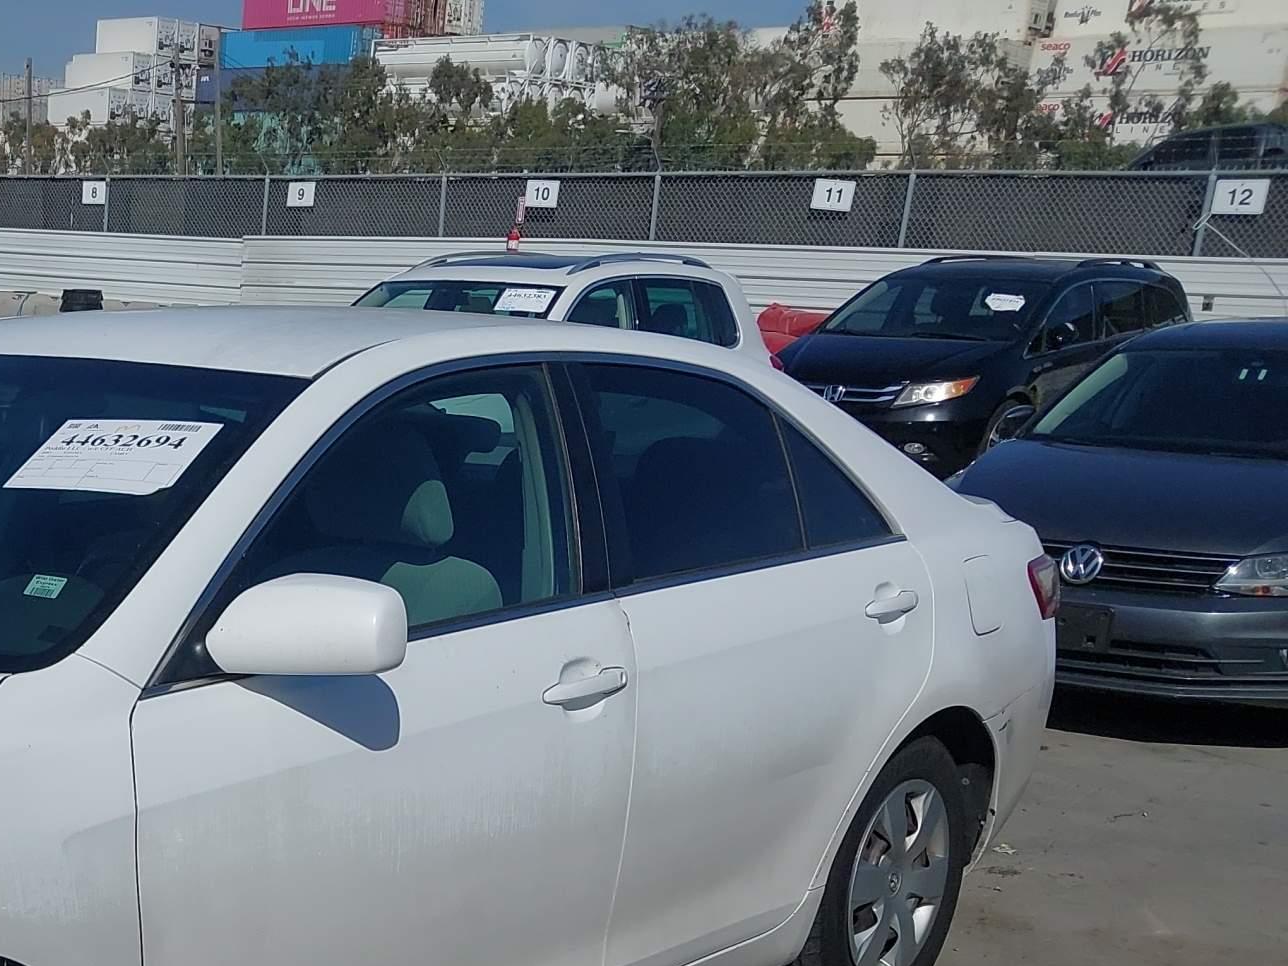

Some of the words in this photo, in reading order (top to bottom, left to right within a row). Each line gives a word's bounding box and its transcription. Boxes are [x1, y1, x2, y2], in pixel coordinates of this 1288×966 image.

[1040, 42, 1071, 51] seaco
[91, 186, 98, 199] 8
[297, 187, 305, 201] 9
[534, 187, 550, 200] 10
[825, 187, 843, 203] 11
[1228, 188, 1253, 206] 12
[61, 433, 188, 450] 44632694
